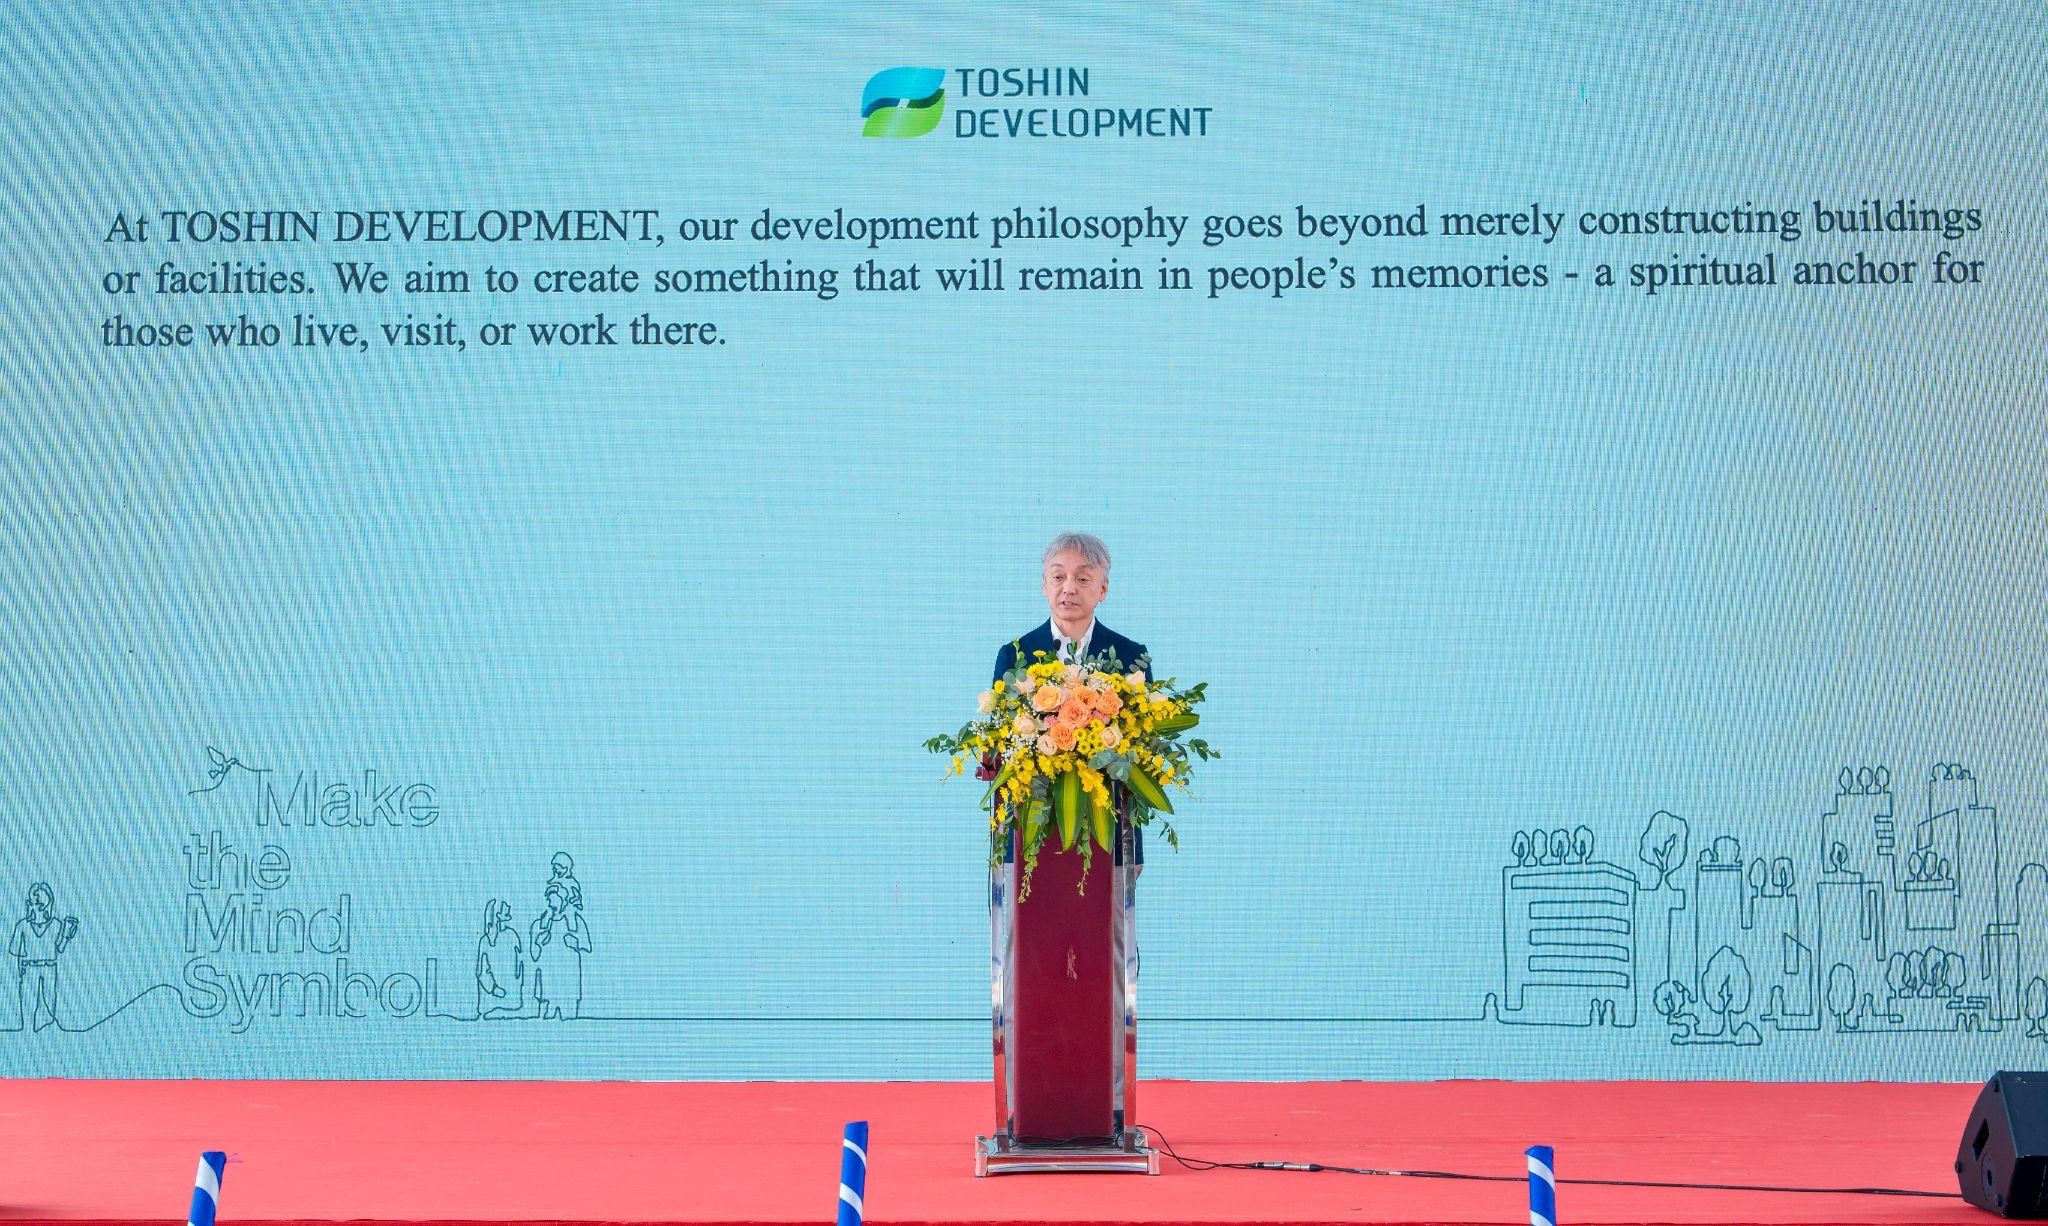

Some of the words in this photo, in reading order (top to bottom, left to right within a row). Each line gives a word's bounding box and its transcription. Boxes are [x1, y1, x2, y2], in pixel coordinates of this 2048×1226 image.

[955, 67, 1089, 97] TOSHIN
[955, 107, 1213, 138] DEVELOPMENT
[105, 212, 147, 243] At
[160, 210, 318, 243] TOSHIN
[334, 209, 665, 247] DEVELOPMENT,
[677, 218, 739, 241] our
[749, 207, 978, 249] development
[990, 205, 1188, 249] philosophy
[1201, 215, 1283, 248] goes
[1295, 203, 1428, 246] beyond
[1440, 202, 1564, 245] merely
[1577, 201, 1801, 242] constructing
[1812, 199, 1982, 241] buildings
[101, 272, 141, 295] or
[156, 261, 314, 294] facilities.
[333, 262, 388, 294] We
[403, 262, 469, 294] aim
[484, 267, 519, 293] to
[532, 266, 639, 294] create
[653, 259, 839, 299] something
[852, 259, 920, 292] that
[935, 258, 1004, 291] will
[1019, 258, 1142, 291] remain
[1158, 257, 1192, 290] in
[1370, 255, 1549, 289] memories
[1593, 264, 1615, 288] a
[1628, 253, 1776, 295] spiritual
[1792, 252, 1916, 285] anchor
[1933, 251, 1984, 284] for
[101, 315, 193, 347] those
[205, 314, 281, 347] who
[293, 314, 369, 351] live,
[381, 313, 466, 350] visit,
[478, 323, 516, 346] or
[527, 313, 616, 346] work
[629, 313, 726, 346] there.
[256, 769, 440, 827] Make
[183, 831, 291, 890] the
[184, 893, 351, 954] Mind
[180, 956, 438, 1034] Symbol
